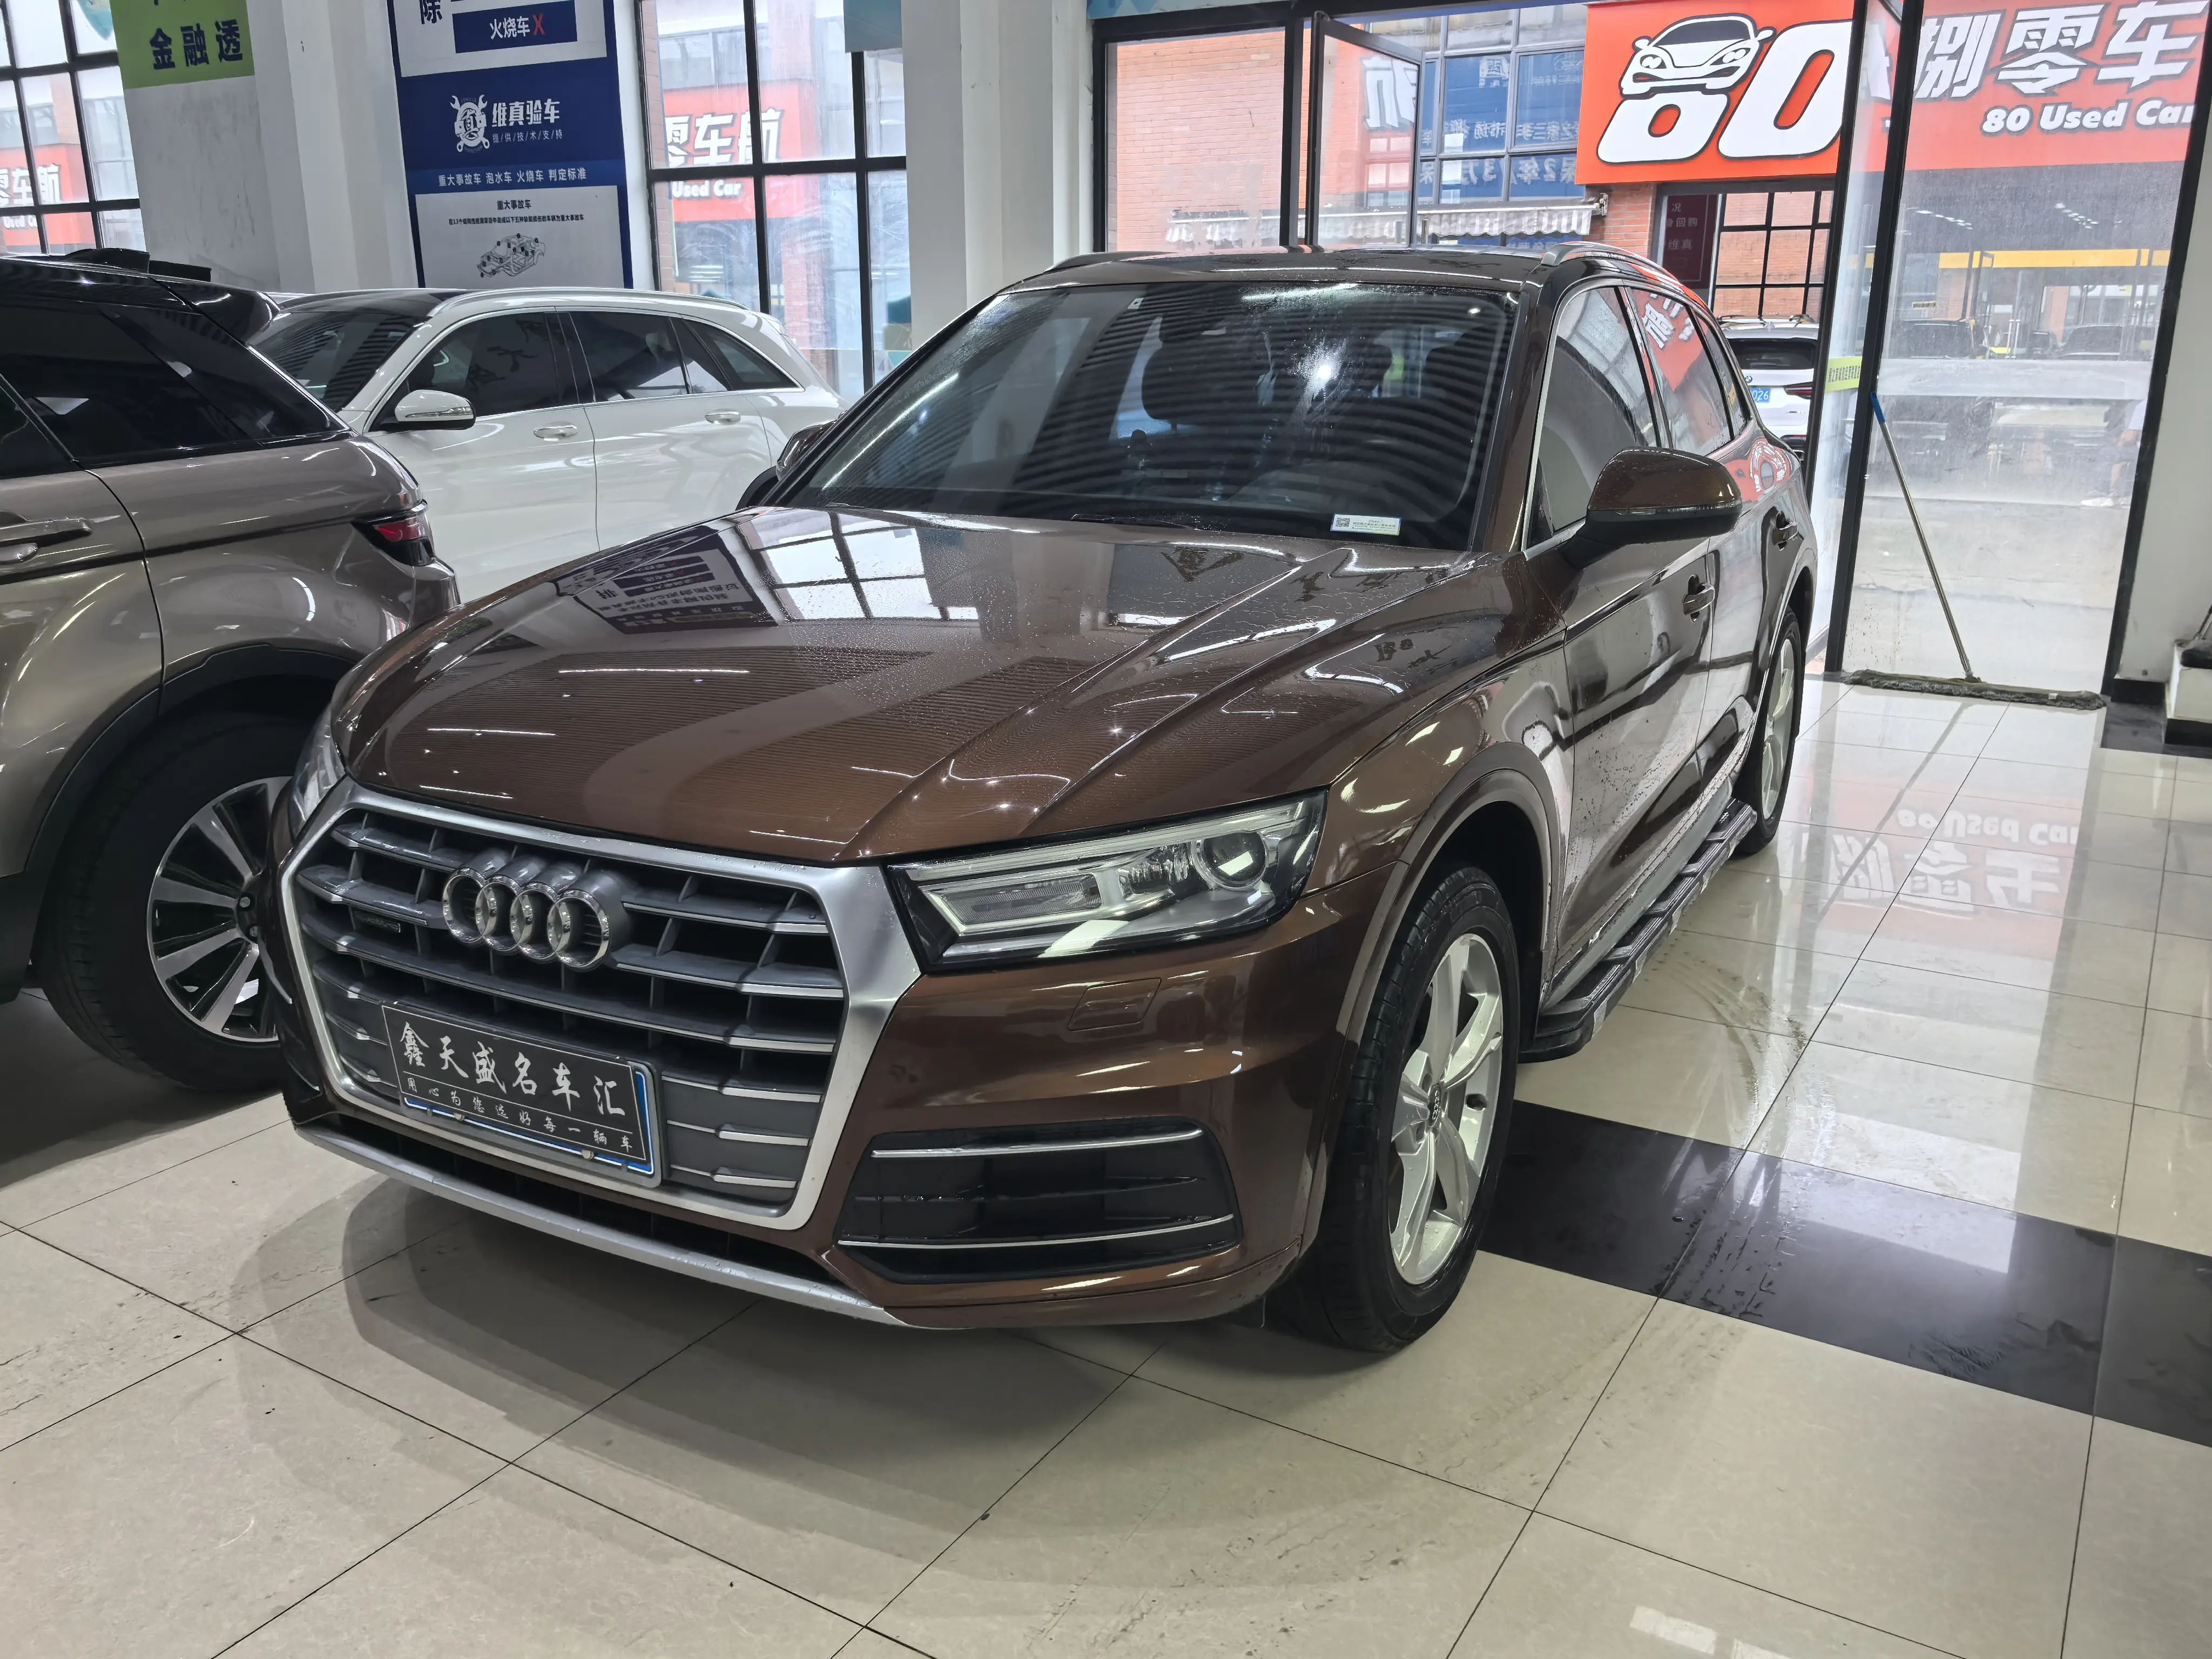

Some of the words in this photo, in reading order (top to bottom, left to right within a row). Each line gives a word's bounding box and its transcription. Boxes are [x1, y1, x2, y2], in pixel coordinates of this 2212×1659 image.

[489, 16, 530, 39] 火烧车
[150, 19, 243, 70] 金融透
[491, 98, 561, 127] 维真验车
[1981, 106, 2031, 133] 80
[2040, 102, 2127, 130] Used
[439, 173, 481, 187] 重大事故车
[486, 171, 512, 184] 泡水车
[517, 169, 544, 183] 火烧车
[548, 167, 587, 182] 判定标准
[671, 180, 710, 198] Used
[713, 180, 742, 197] Car
[400, 1021, 625, 1116] 鑫天盛名车汇
[407, 1077, 633, 1153] 用心为您选好每一辆车
